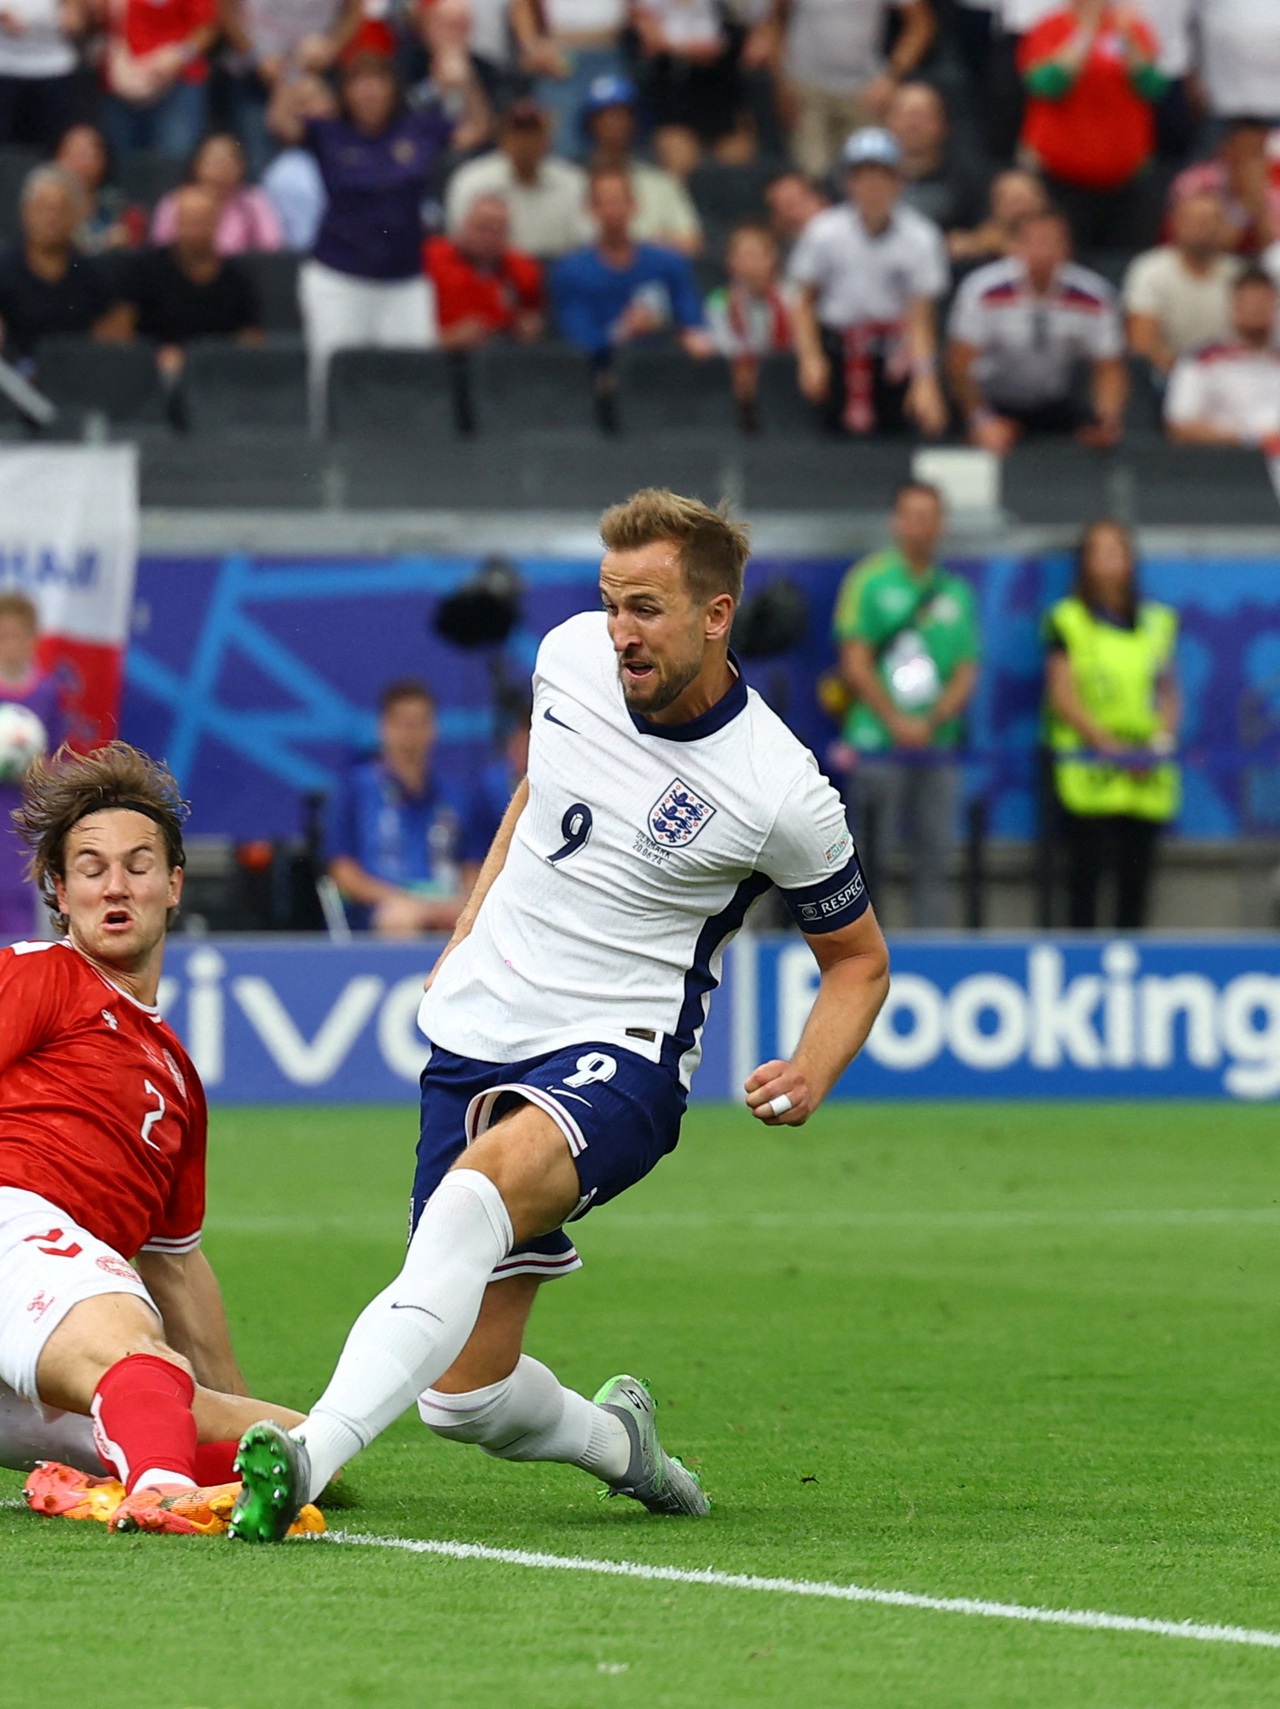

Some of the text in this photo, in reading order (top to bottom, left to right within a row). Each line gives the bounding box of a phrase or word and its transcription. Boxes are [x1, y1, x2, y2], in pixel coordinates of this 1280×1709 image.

[545, 803, 592, 866] 9
[820, 873, 864, 914] RESPECT
[562, 1052, 617, 1088] 9
[140, 1079, 166, 1151] 2
